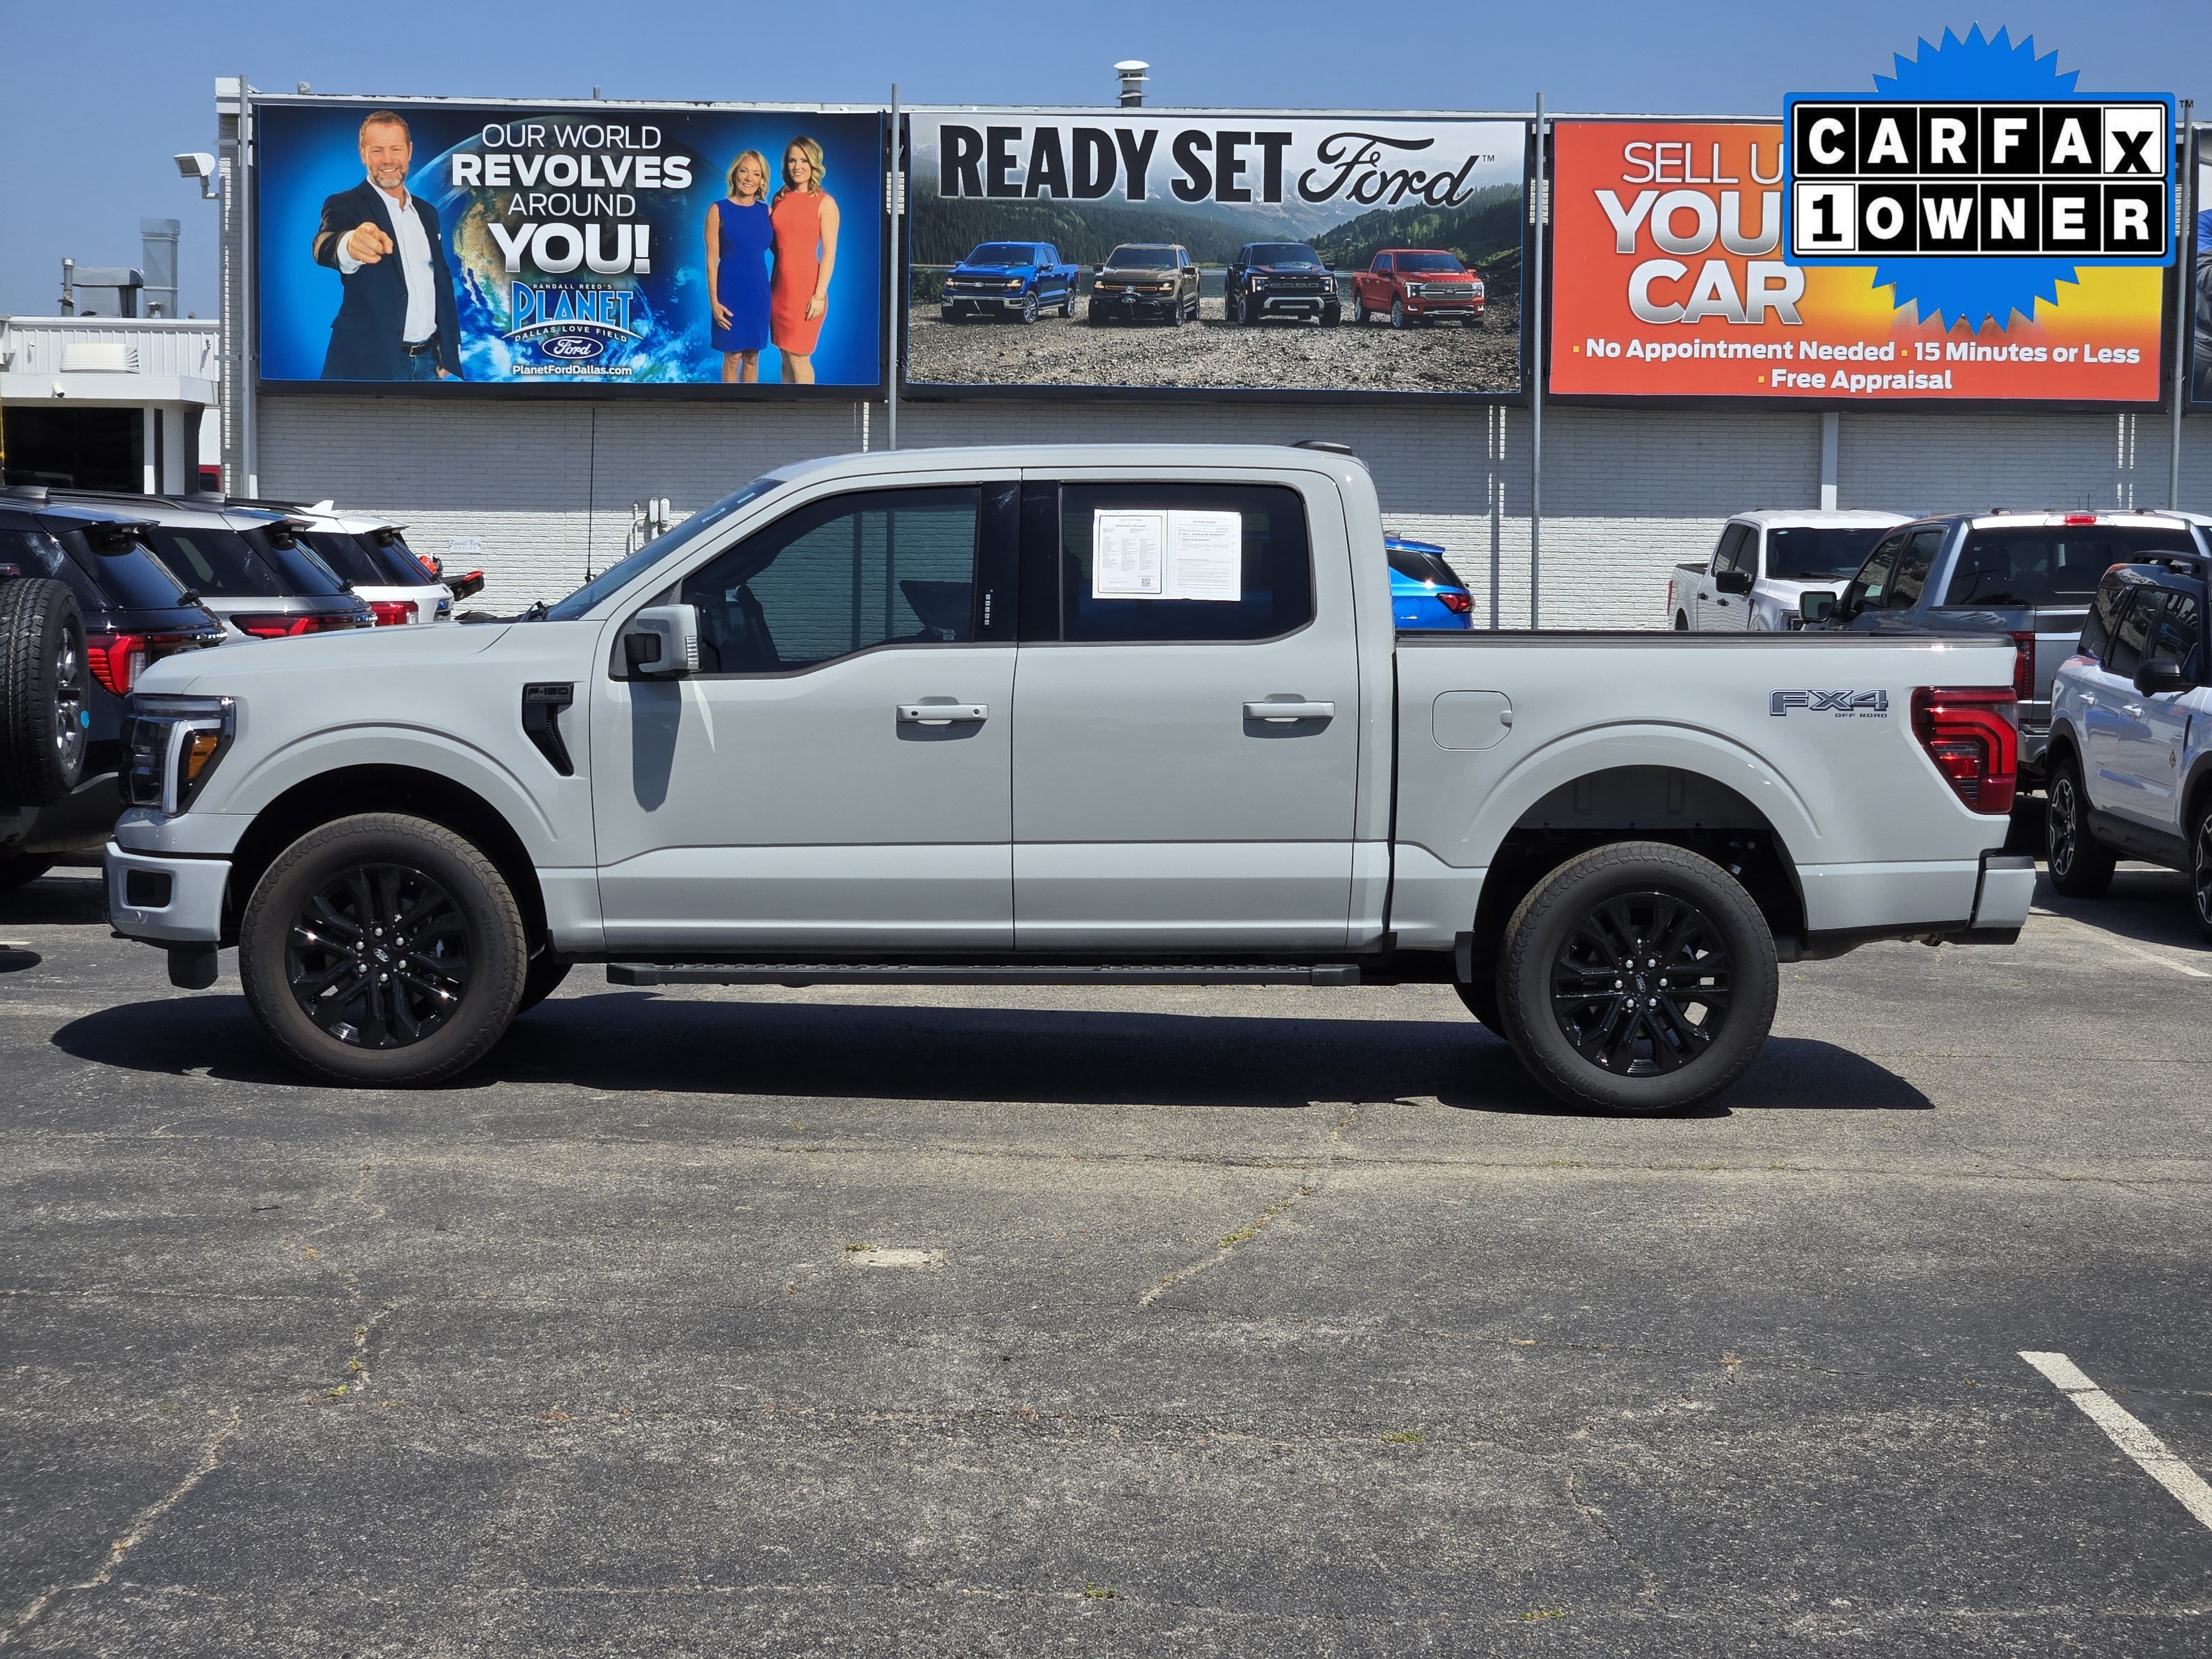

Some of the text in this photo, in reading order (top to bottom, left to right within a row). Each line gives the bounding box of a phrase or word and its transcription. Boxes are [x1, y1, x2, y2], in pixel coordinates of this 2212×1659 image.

[482, 124, 661, 149] OUR WORLD
[452, 153, 692, 189] REVOLVES
[940, 125, 1159, 200] READY
[1171, 129, 1292, 202] SET
[1297, 132, 1480, 207] Ford
[1623, 142, 1783, 184] SELL U
[508, 192, 636, 217] AROUND
[1594, 190, 1783, 256] YOU
[487, 222, 650, 274] YOU!
[1628, 259, 1804, 324] CAR
[512, 281, 634, 332] PLANET
[514, 326, 556, 342] DALLAS
[596, 328, 627, 342] FIELD
[554, 338, 592, 355] Ford
[1586, 338, 2140, 364] No Appointment Needed 15 Minutes or Less
[513, 365, 632, 375] PlanetFordDallas.com
[1771, 368, 1952, 393] Free Appraisal
[1770, 688, 1889, 716] FX4
